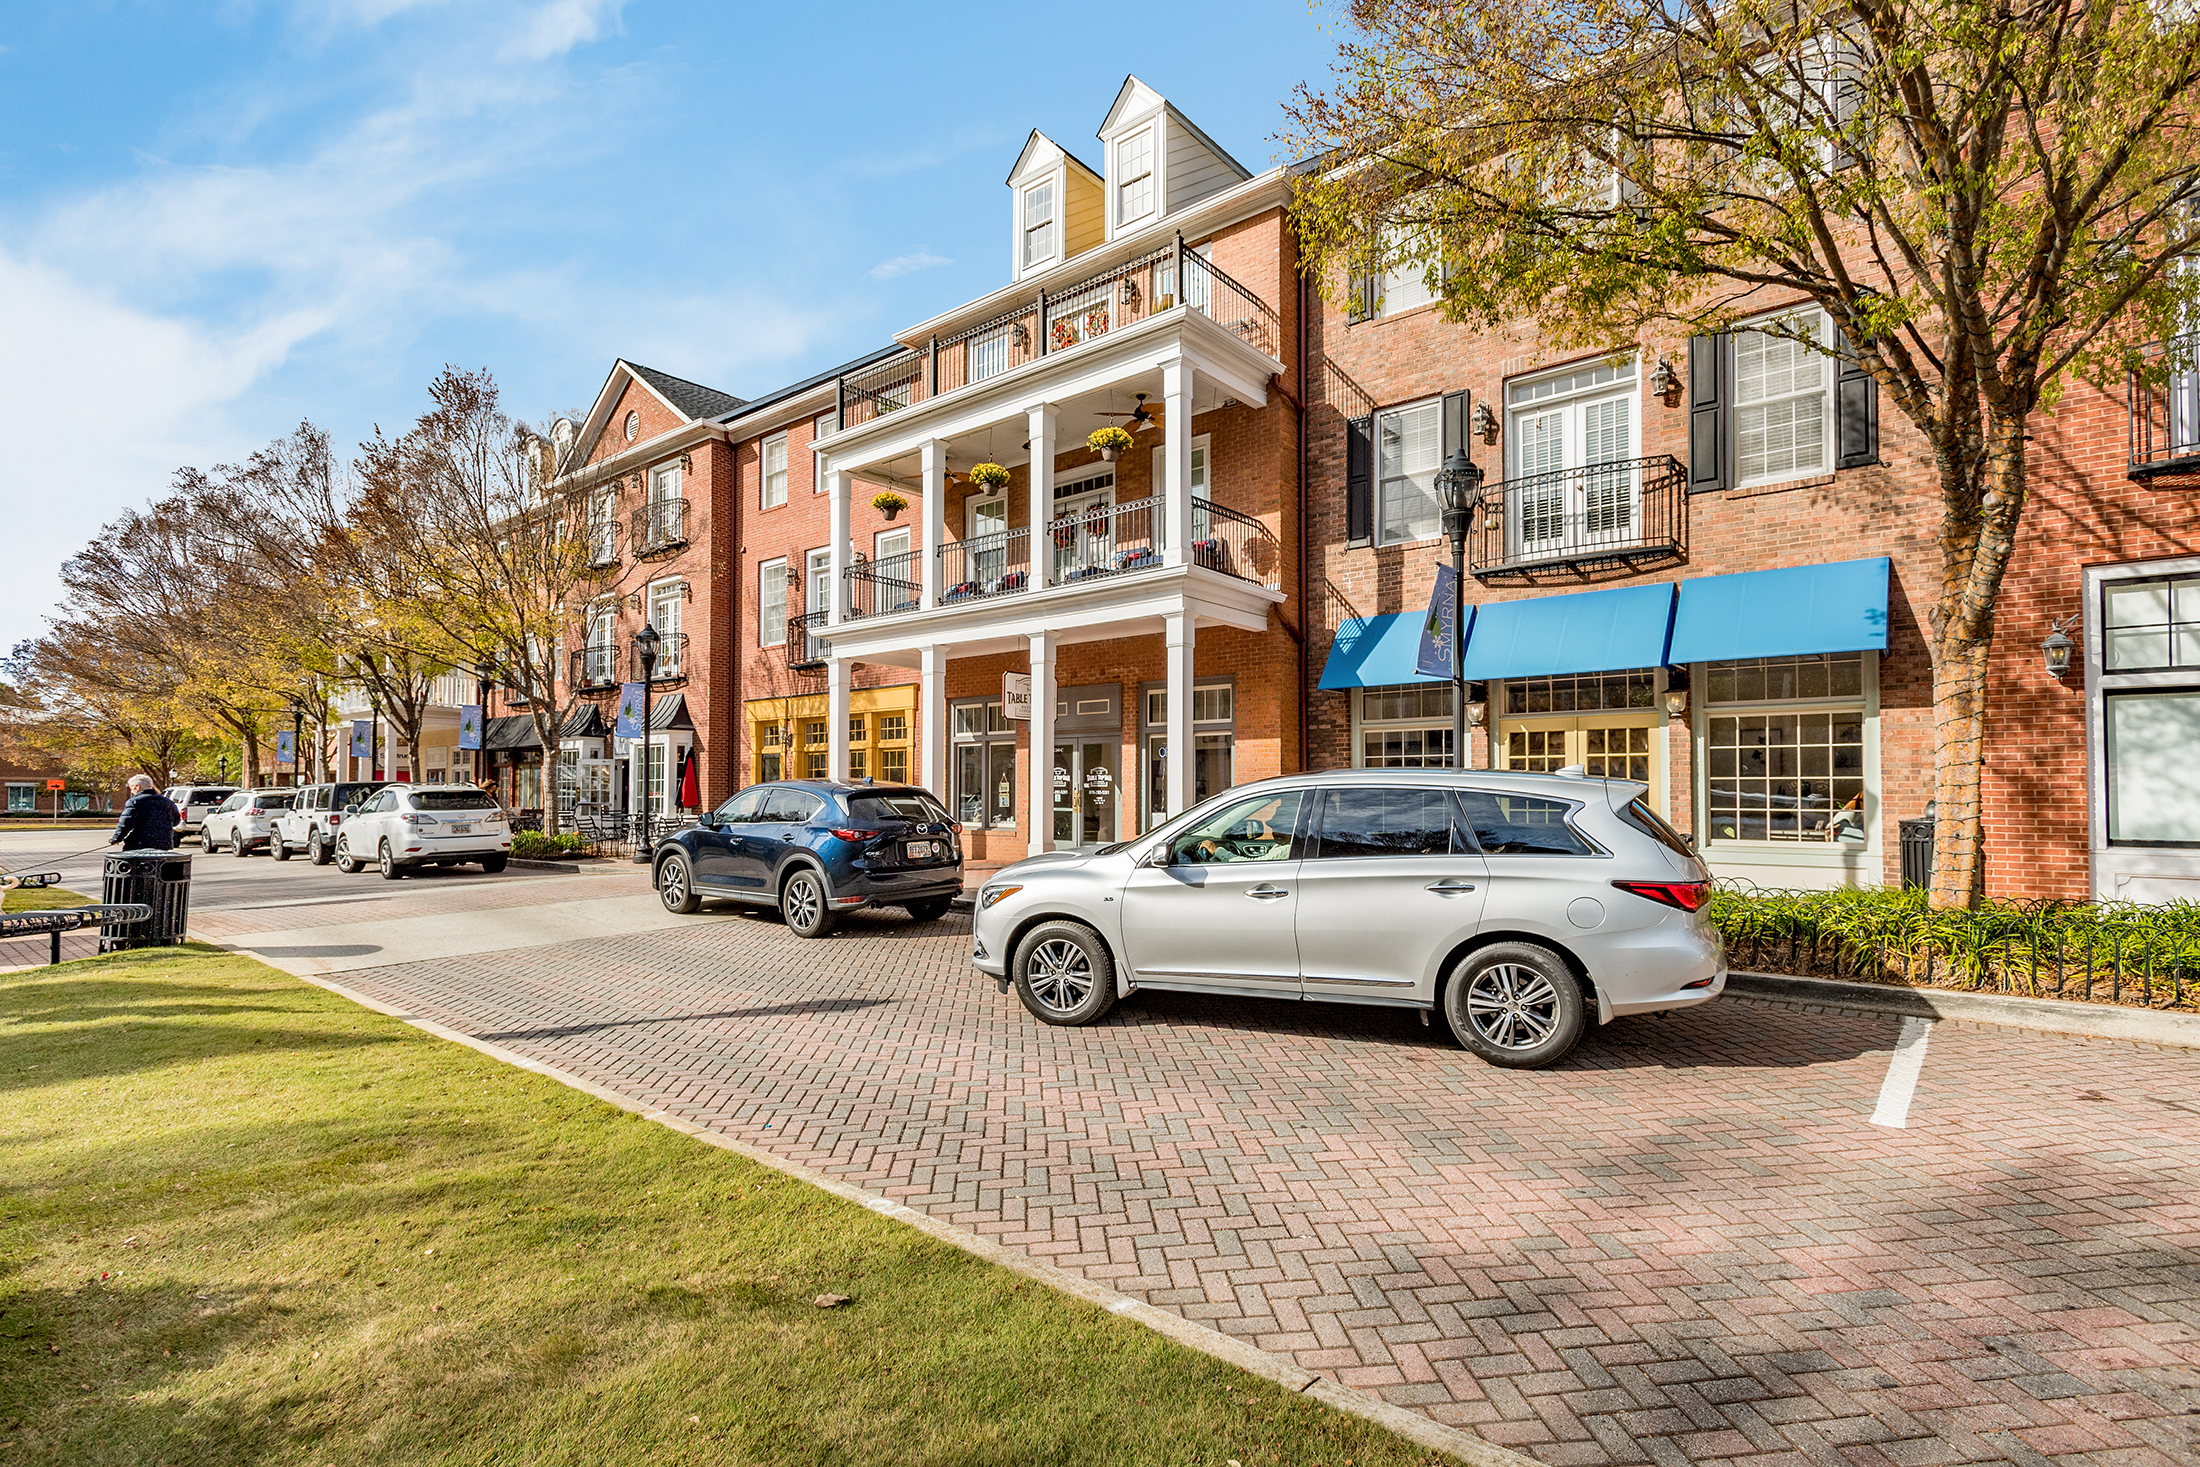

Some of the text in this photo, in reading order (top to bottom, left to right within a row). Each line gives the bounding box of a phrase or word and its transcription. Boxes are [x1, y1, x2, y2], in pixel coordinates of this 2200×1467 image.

[1438, 581, 1456, 662] SMYRNA
[631, 690, 644, 731] SMYRNA
[1007, 691, 1028, 705] TABLE
[472, 710, 481, 743] SMYRNA
